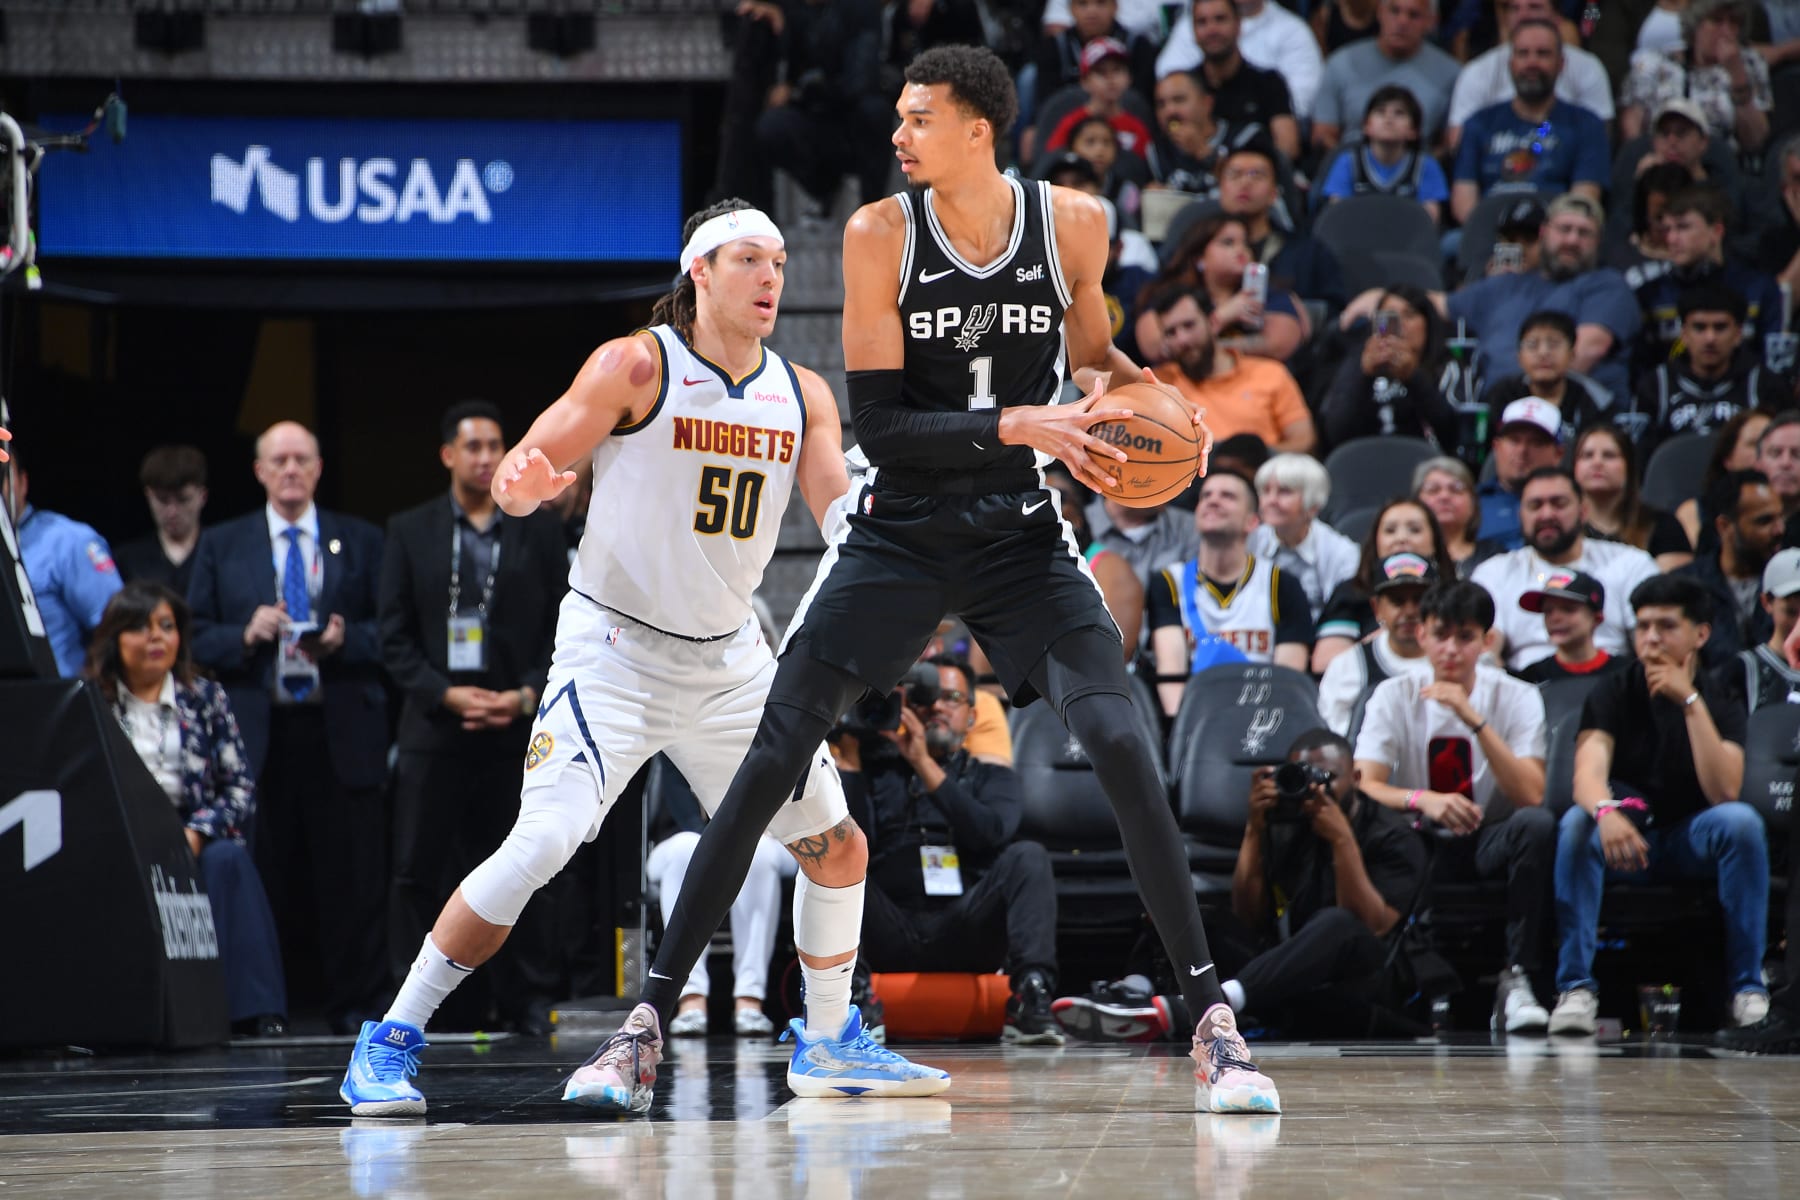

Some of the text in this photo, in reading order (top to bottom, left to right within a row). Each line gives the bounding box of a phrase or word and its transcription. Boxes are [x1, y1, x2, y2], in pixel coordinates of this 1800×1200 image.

[908, 303, 1053, 352] SPURS
[754, 391, 789, 405] ibotta
[967, 356, 997, 412] 1
[672, 415, 796, 464] NUGGETS
[693, 463, 768, 541] 50
